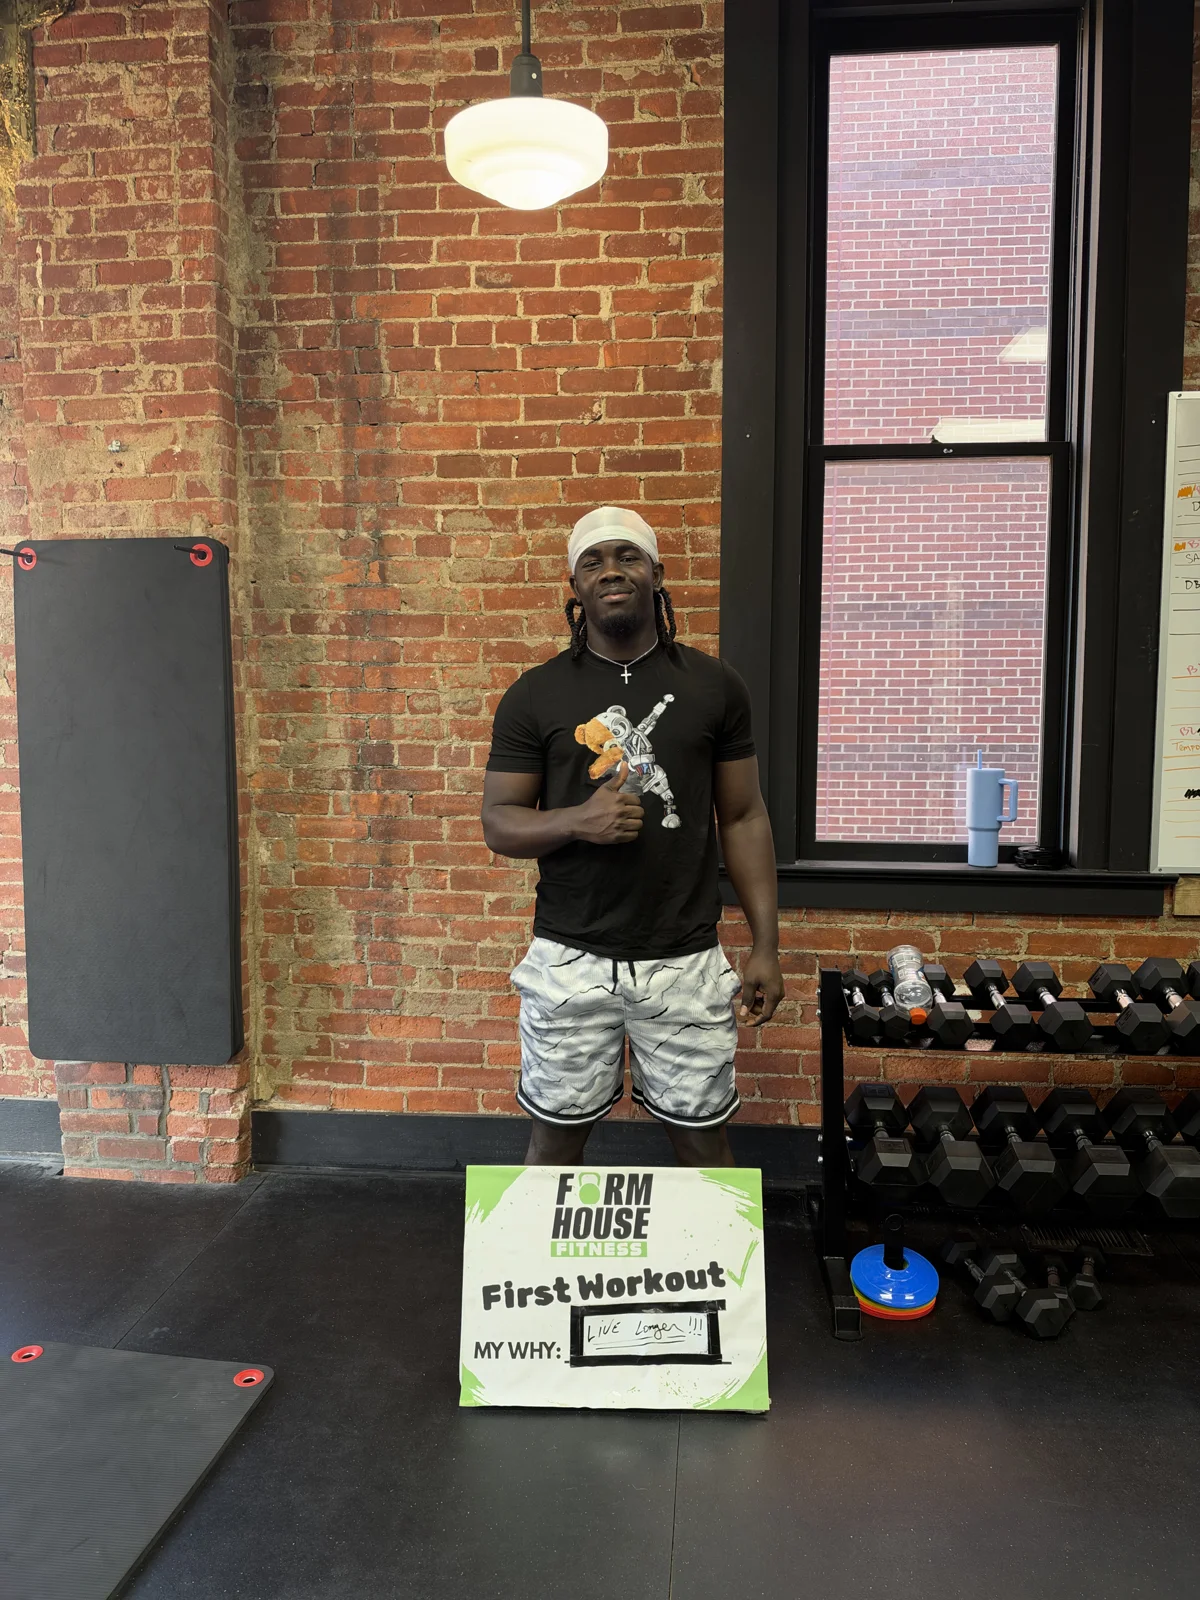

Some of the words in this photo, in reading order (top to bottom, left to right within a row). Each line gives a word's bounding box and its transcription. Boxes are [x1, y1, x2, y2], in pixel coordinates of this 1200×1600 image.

[551, 1207, 651, 1240] HOUSE
[556, 1242, 642, 1257] FITNESS
[482, 1276, 572, 1311] First
[577, 1261, 727, 1301] Workout
[473, 1341, 504, 1360] MY
[507, 1341, 562, 1360] WHY:
